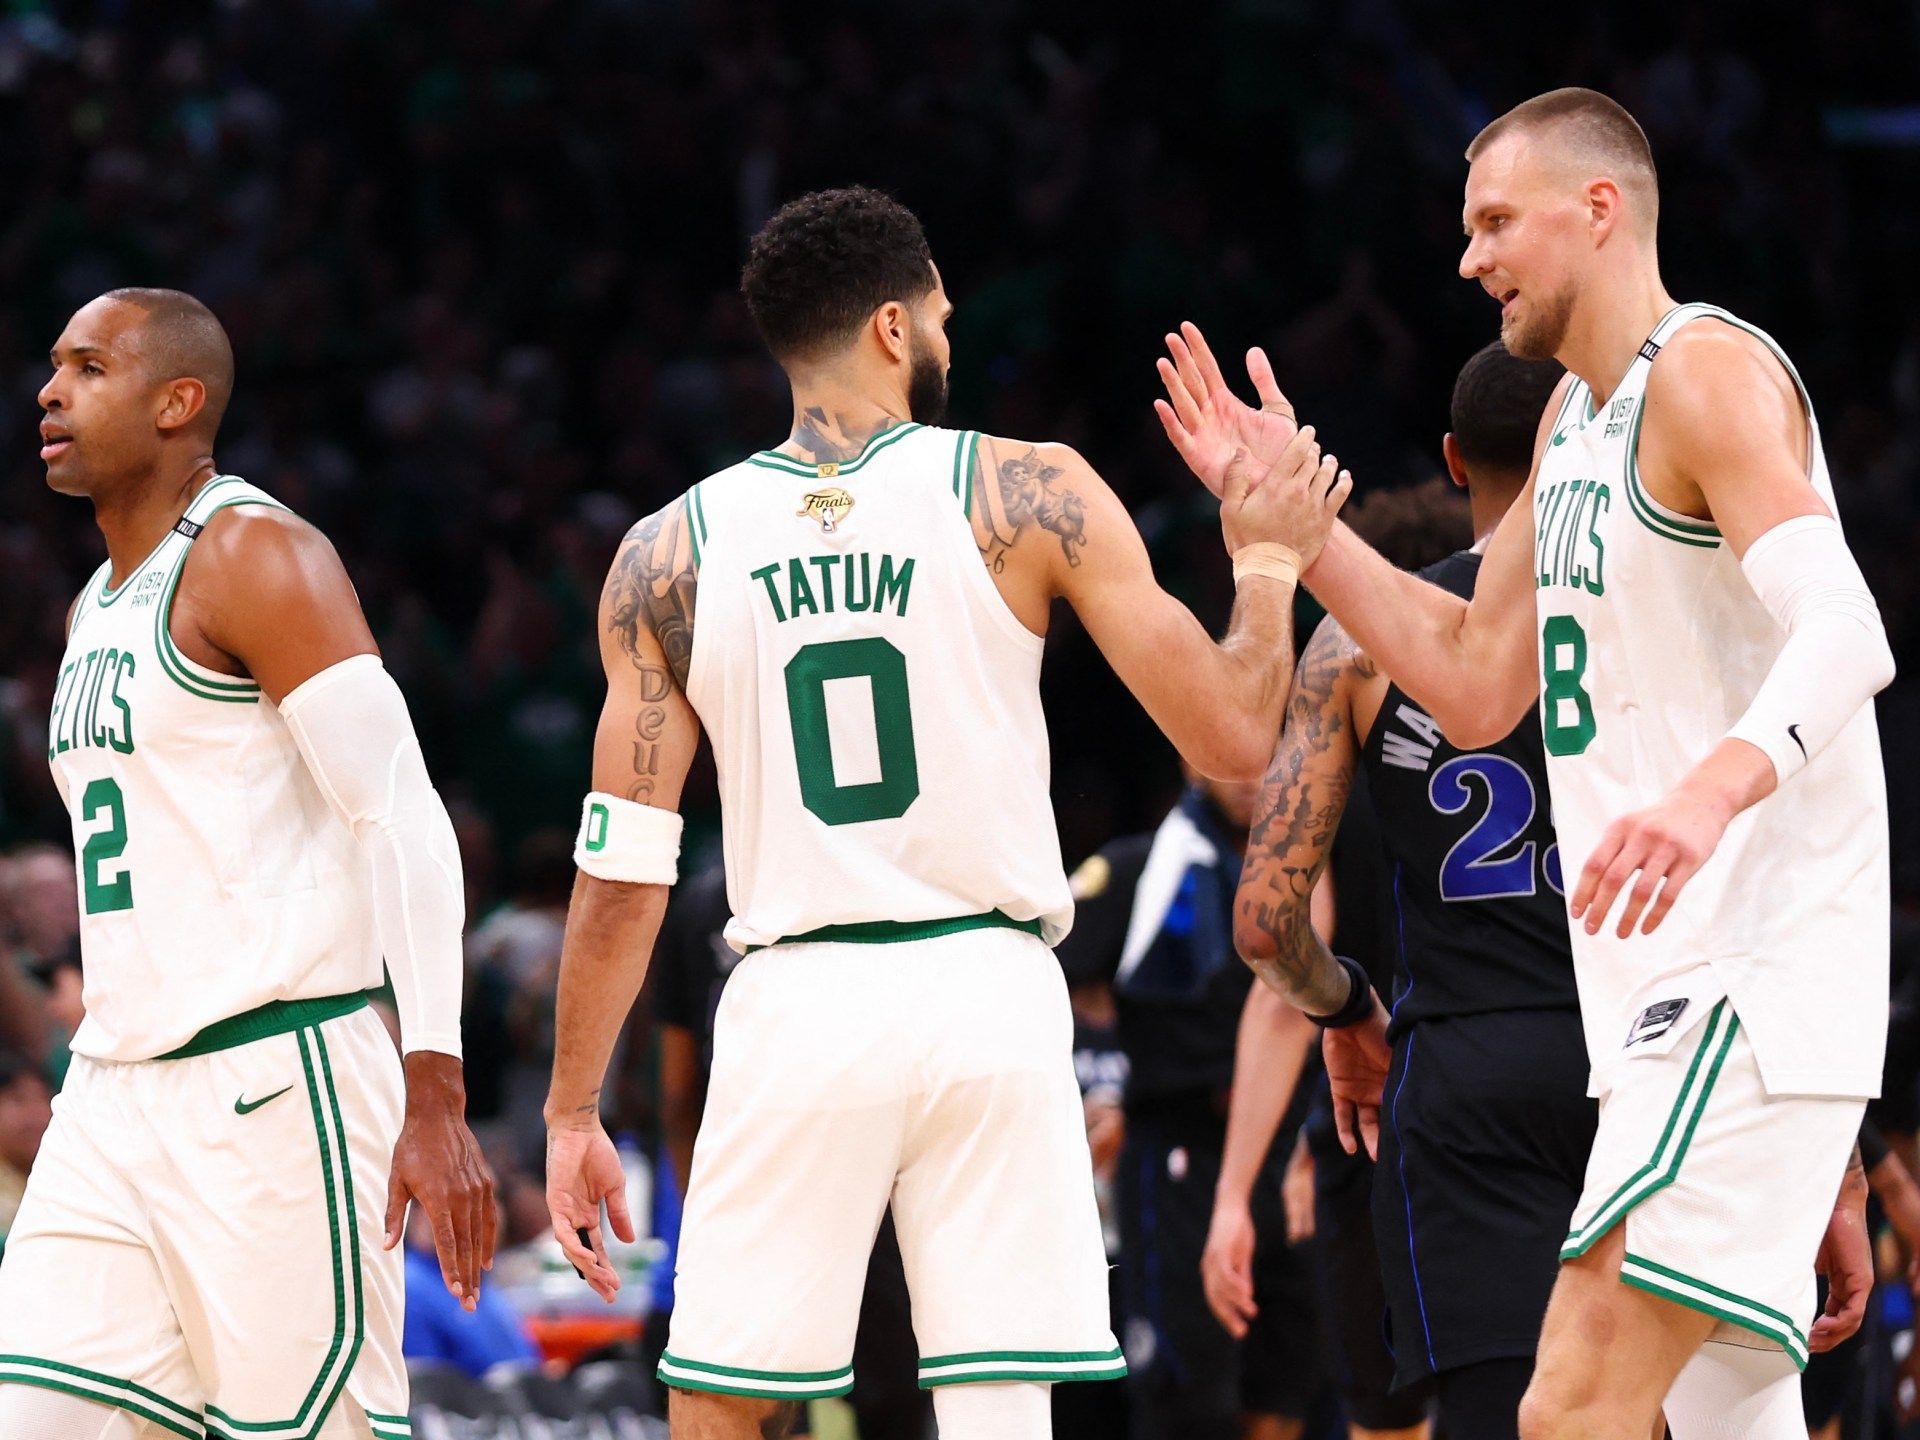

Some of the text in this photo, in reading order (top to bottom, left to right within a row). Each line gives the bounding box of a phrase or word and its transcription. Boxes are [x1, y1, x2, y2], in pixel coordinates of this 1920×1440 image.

[800, 491, 853, 514] Finals
[1536, 479, 1610, 597] ELTICS
[130, 592, 157, 609] PRINT
[137, 571, 165, 592] VISTA
[750, 552, 916, 623] TATUM
[48, 648, 136, 762] ELTICS
[784, 636, 919, 826] 0
[1543, 615, 1597, 757] 8
[82, 776, 134, 915] 2
[586, 802, 609, 852] 0
[1428, 753, 1565, 902] 2
